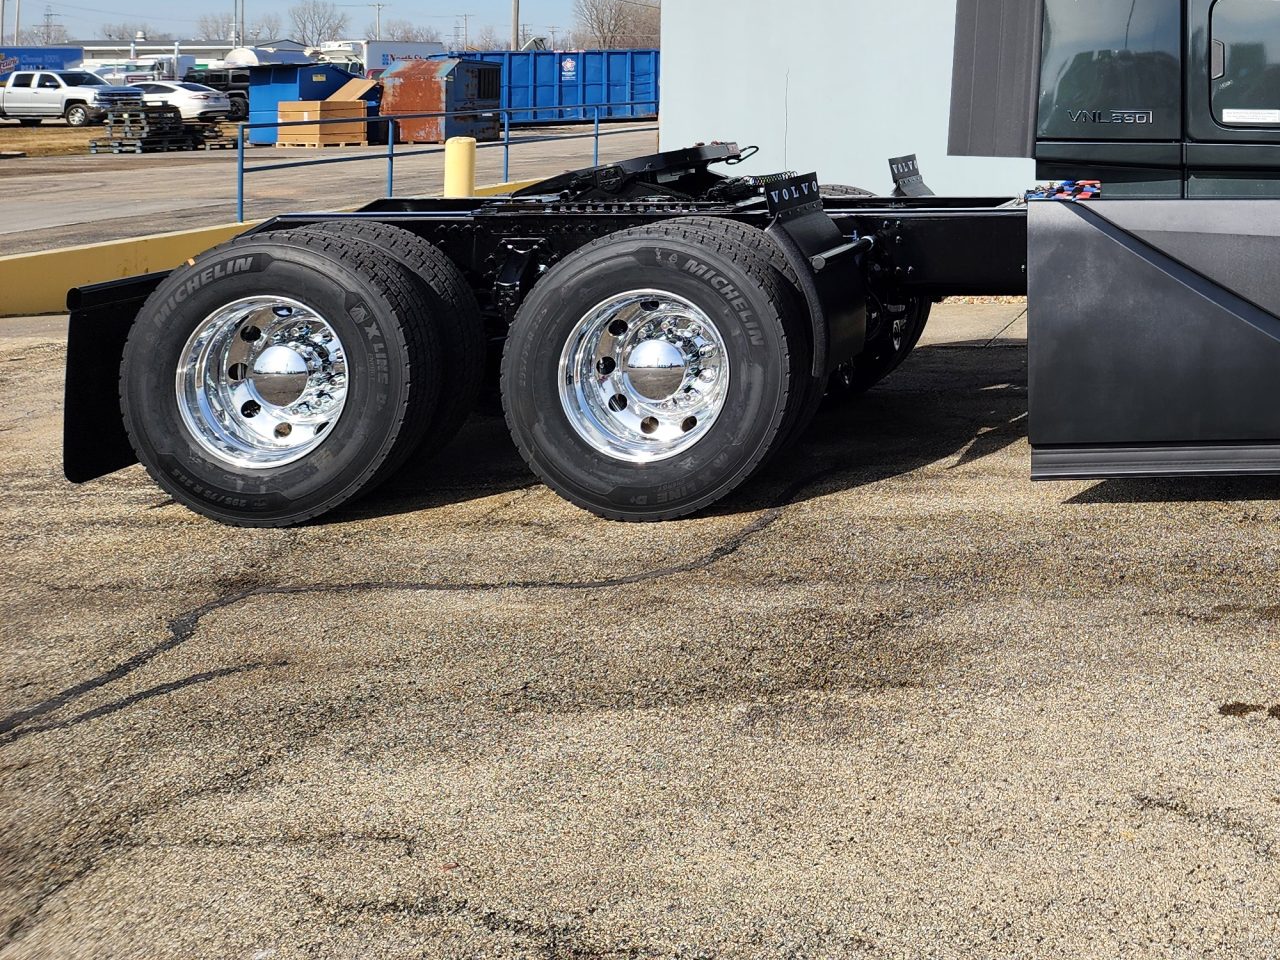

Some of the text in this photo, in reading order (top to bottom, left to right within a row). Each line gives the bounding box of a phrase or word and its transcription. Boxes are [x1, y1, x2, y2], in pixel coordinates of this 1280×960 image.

[892, 160, 918, 174] VOLVO
[770, 181, 818, 203] VOLVO
[153, 256, 254, 328] MICHELIN
[684, 259, 764, 346] MICHELIN
[364, 321, 381, 341] X
[372, 342, 389, 385] LINE
